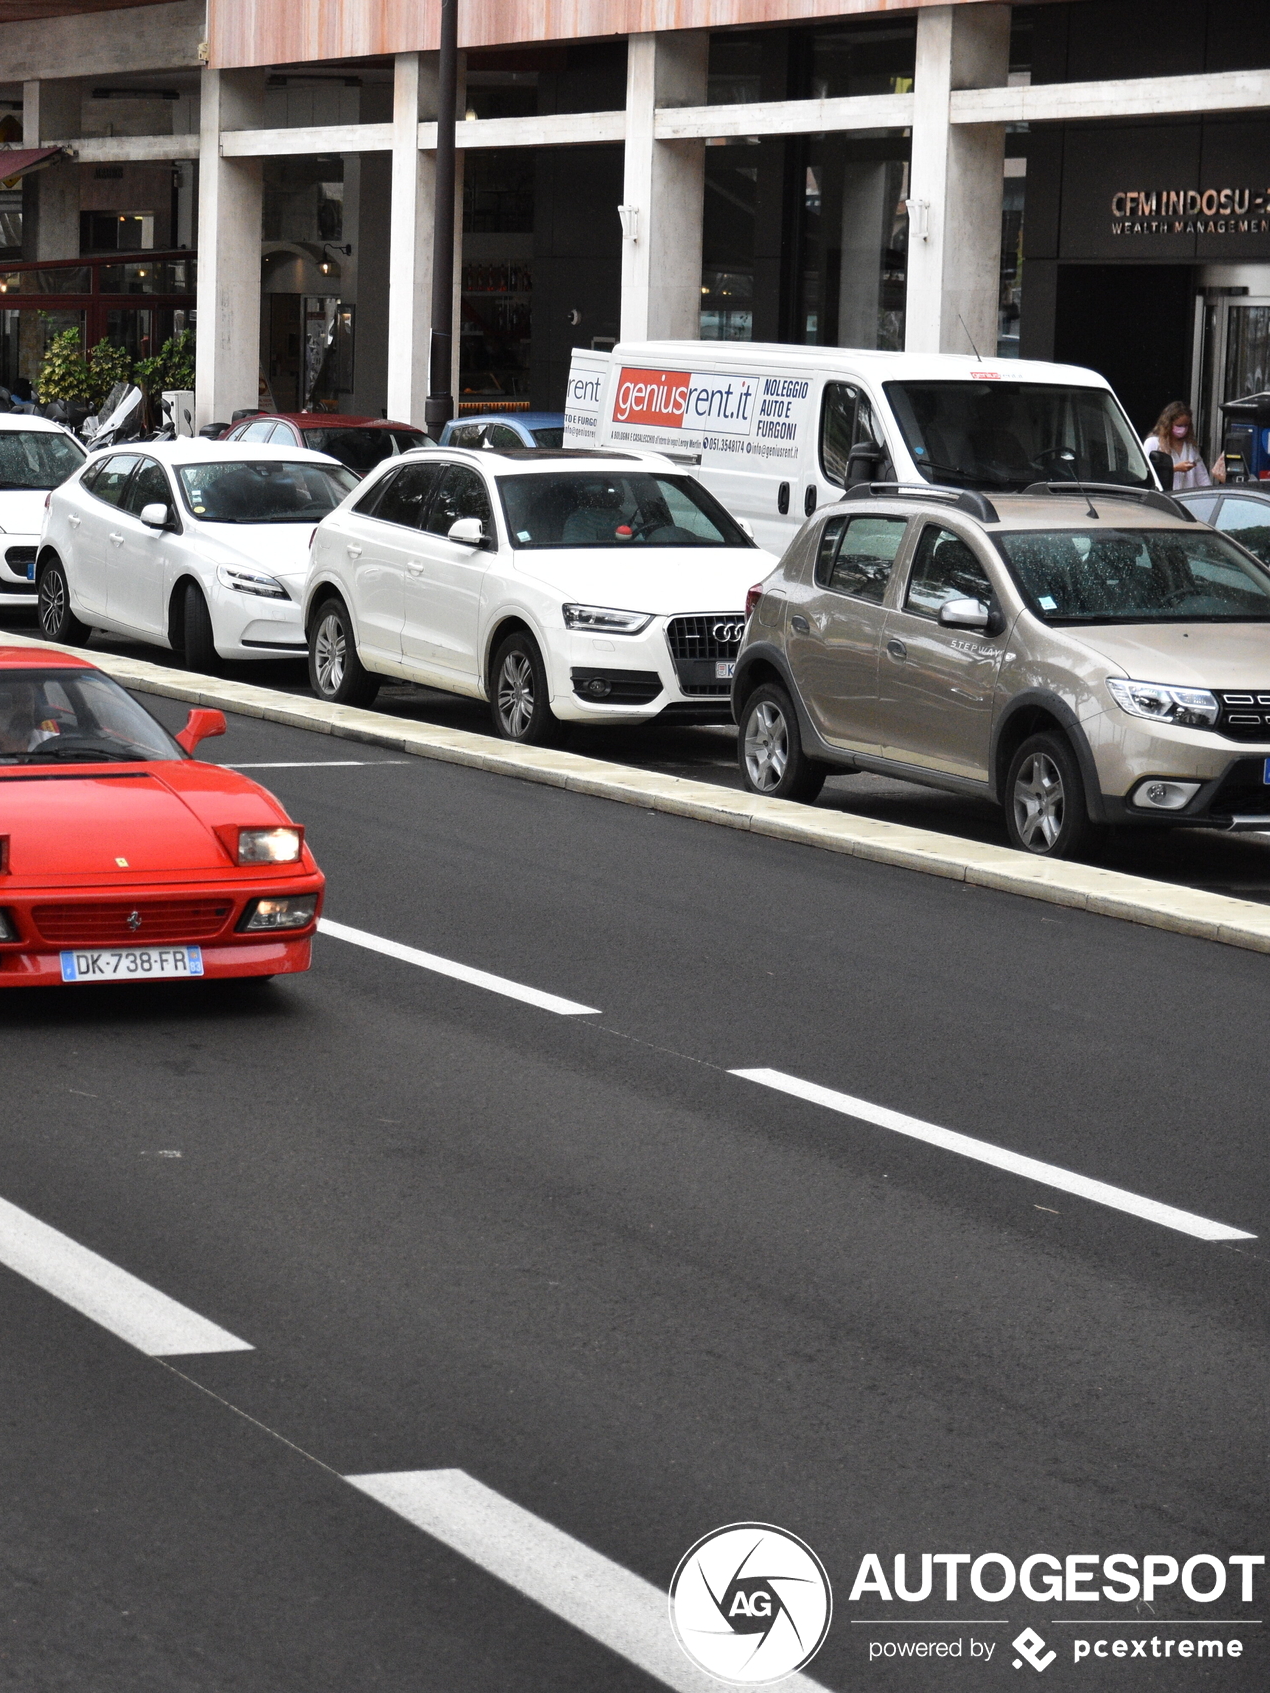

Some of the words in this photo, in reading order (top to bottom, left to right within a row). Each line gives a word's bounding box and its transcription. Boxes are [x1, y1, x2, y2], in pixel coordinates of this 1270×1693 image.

[1112, 191, 1156, 217] CFM
[1112, 222, 1168, 234] WEALTH
[763, 379, 809, 399] NOLEGGIO
[760, 399, 785, 418] AUTO
[785, 402, 792, 418] E
[756, 420, 797, 440] FURGONI
[709, 437, 745, 454] 051.3548174
[950, 640, 1001, 657] STEPWAY
[76, 951, 187, 975] DK-738-FR
[190, 961, 202, 972] 83
